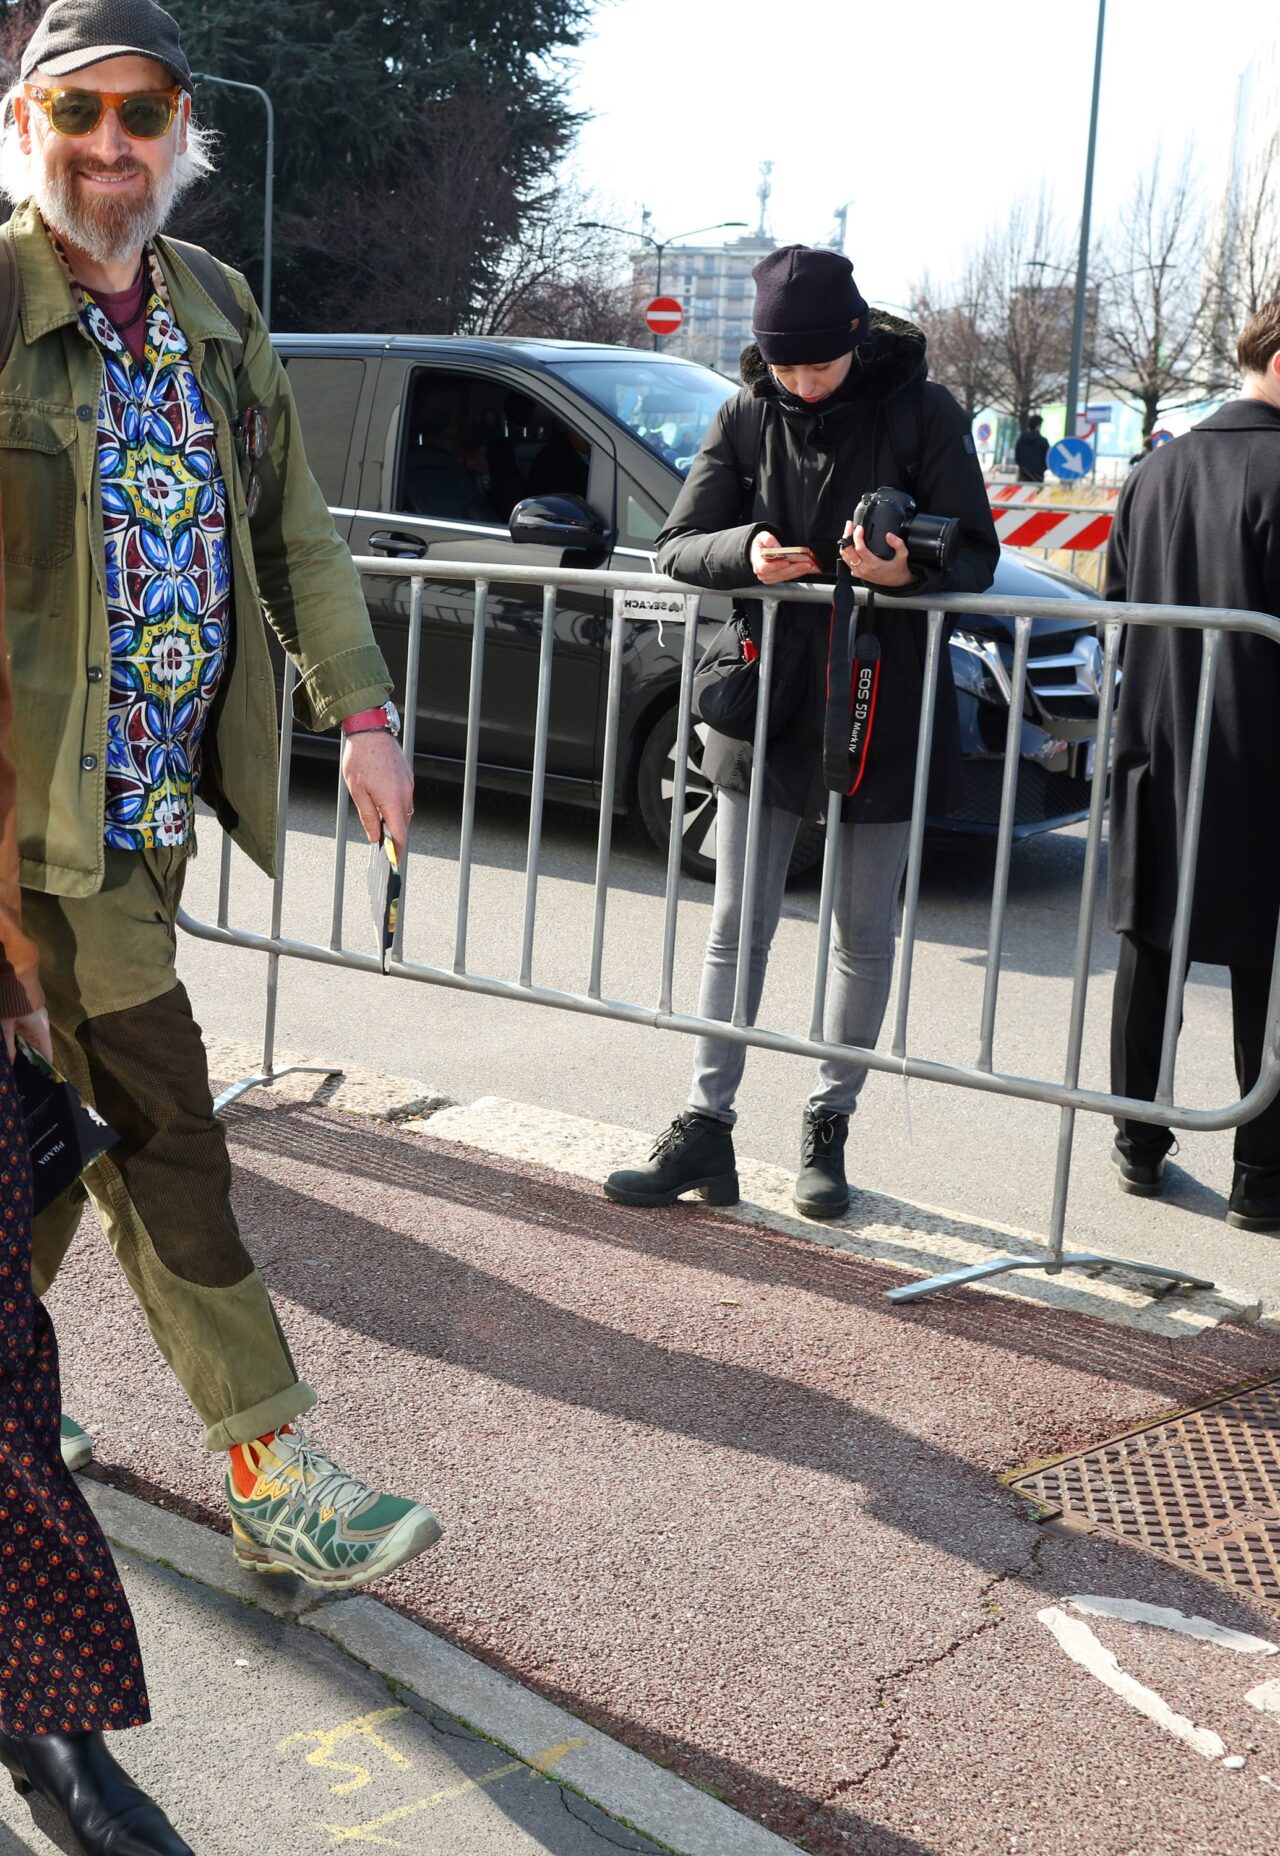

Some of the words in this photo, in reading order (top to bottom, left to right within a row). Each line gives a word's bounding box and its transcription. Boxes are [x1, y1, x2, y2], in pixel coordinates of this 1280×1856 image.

[857, 668, 872, 700] EOS
[855, 703, 867, 720] 5D
[850, 721, 861, 743] Mark
[848, 744, 857, 753] IV
[38, 1140, 65, 1165] PRADA
